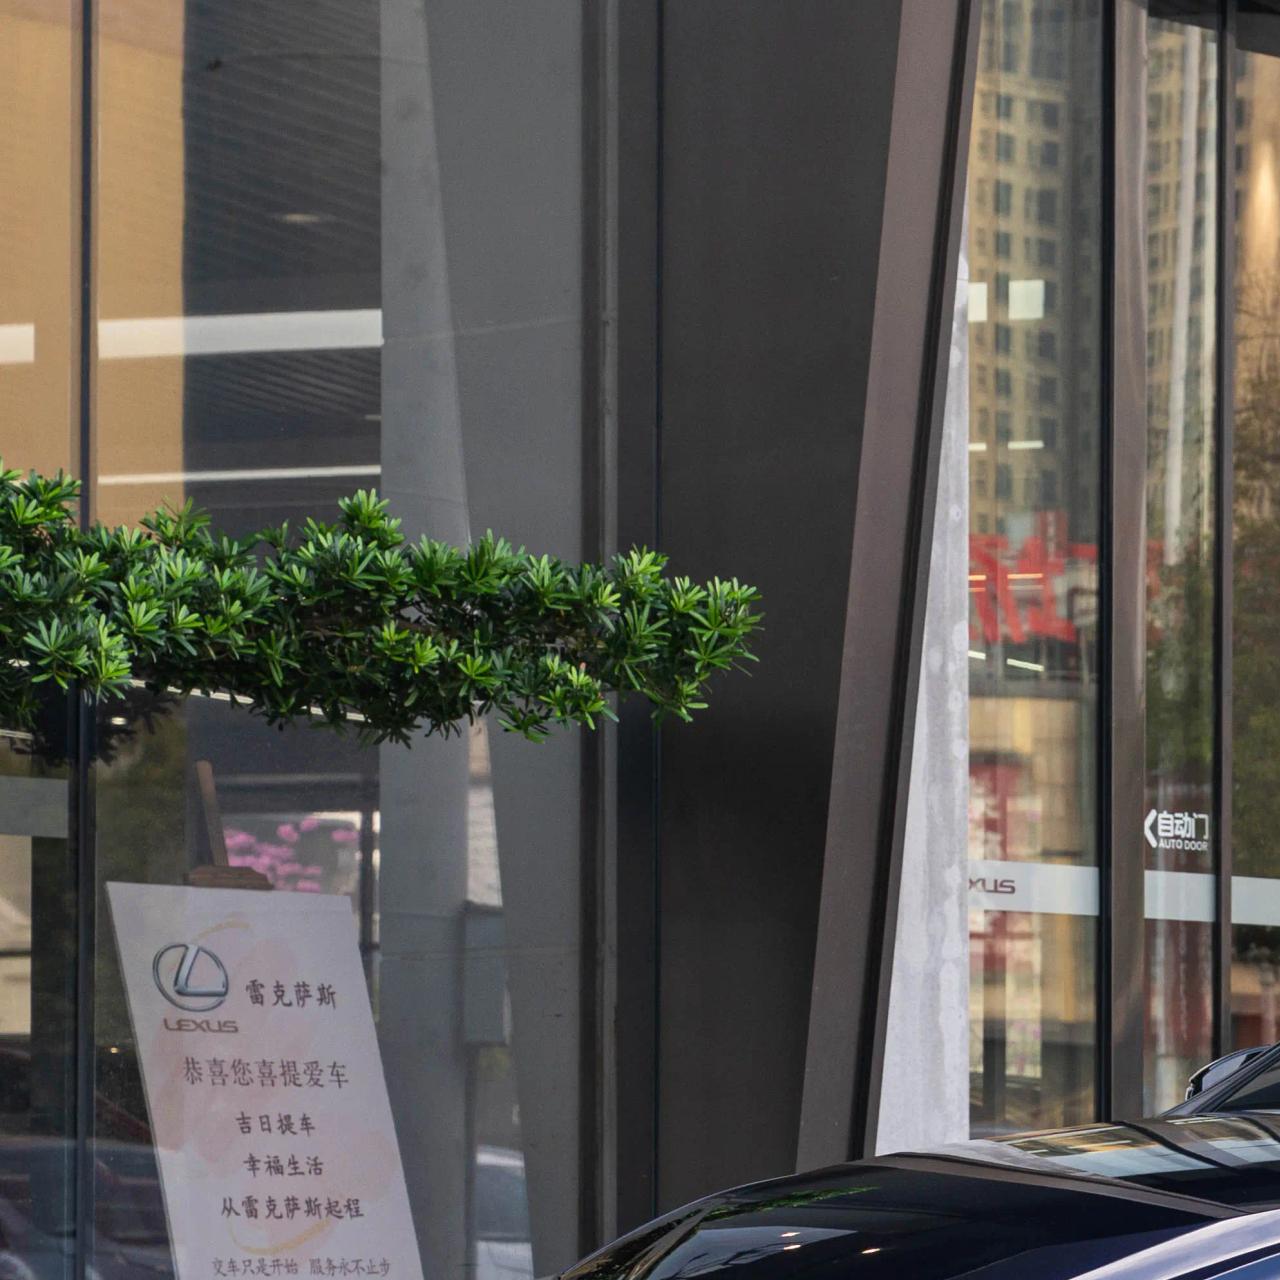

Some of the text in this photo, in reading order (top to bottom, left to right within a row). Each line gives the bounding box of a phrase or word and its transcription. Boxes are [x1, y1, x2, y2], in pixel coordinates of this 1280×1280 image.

[1157, 812, 1210, 839] 自动门
[1158, 837, 1209, 851] AUTO DOOR
[968, 877, 1016, 895] XUS
[245, 979, 337, 1010] 雷克萨斯
[163, 1018, 240, 1034] LEXUS
[183, 1056, 350, 1089] 恭喜您喜提爱车
[235, 1111, 317, 1137] 吉日提车
[243, 1153, 325, 1178] 幸福生活
[221, 1194, 366, 1220] 从雷克萨斯起程
[212, 1256, 392, 1278] 交车只是开始 服务永不止步
